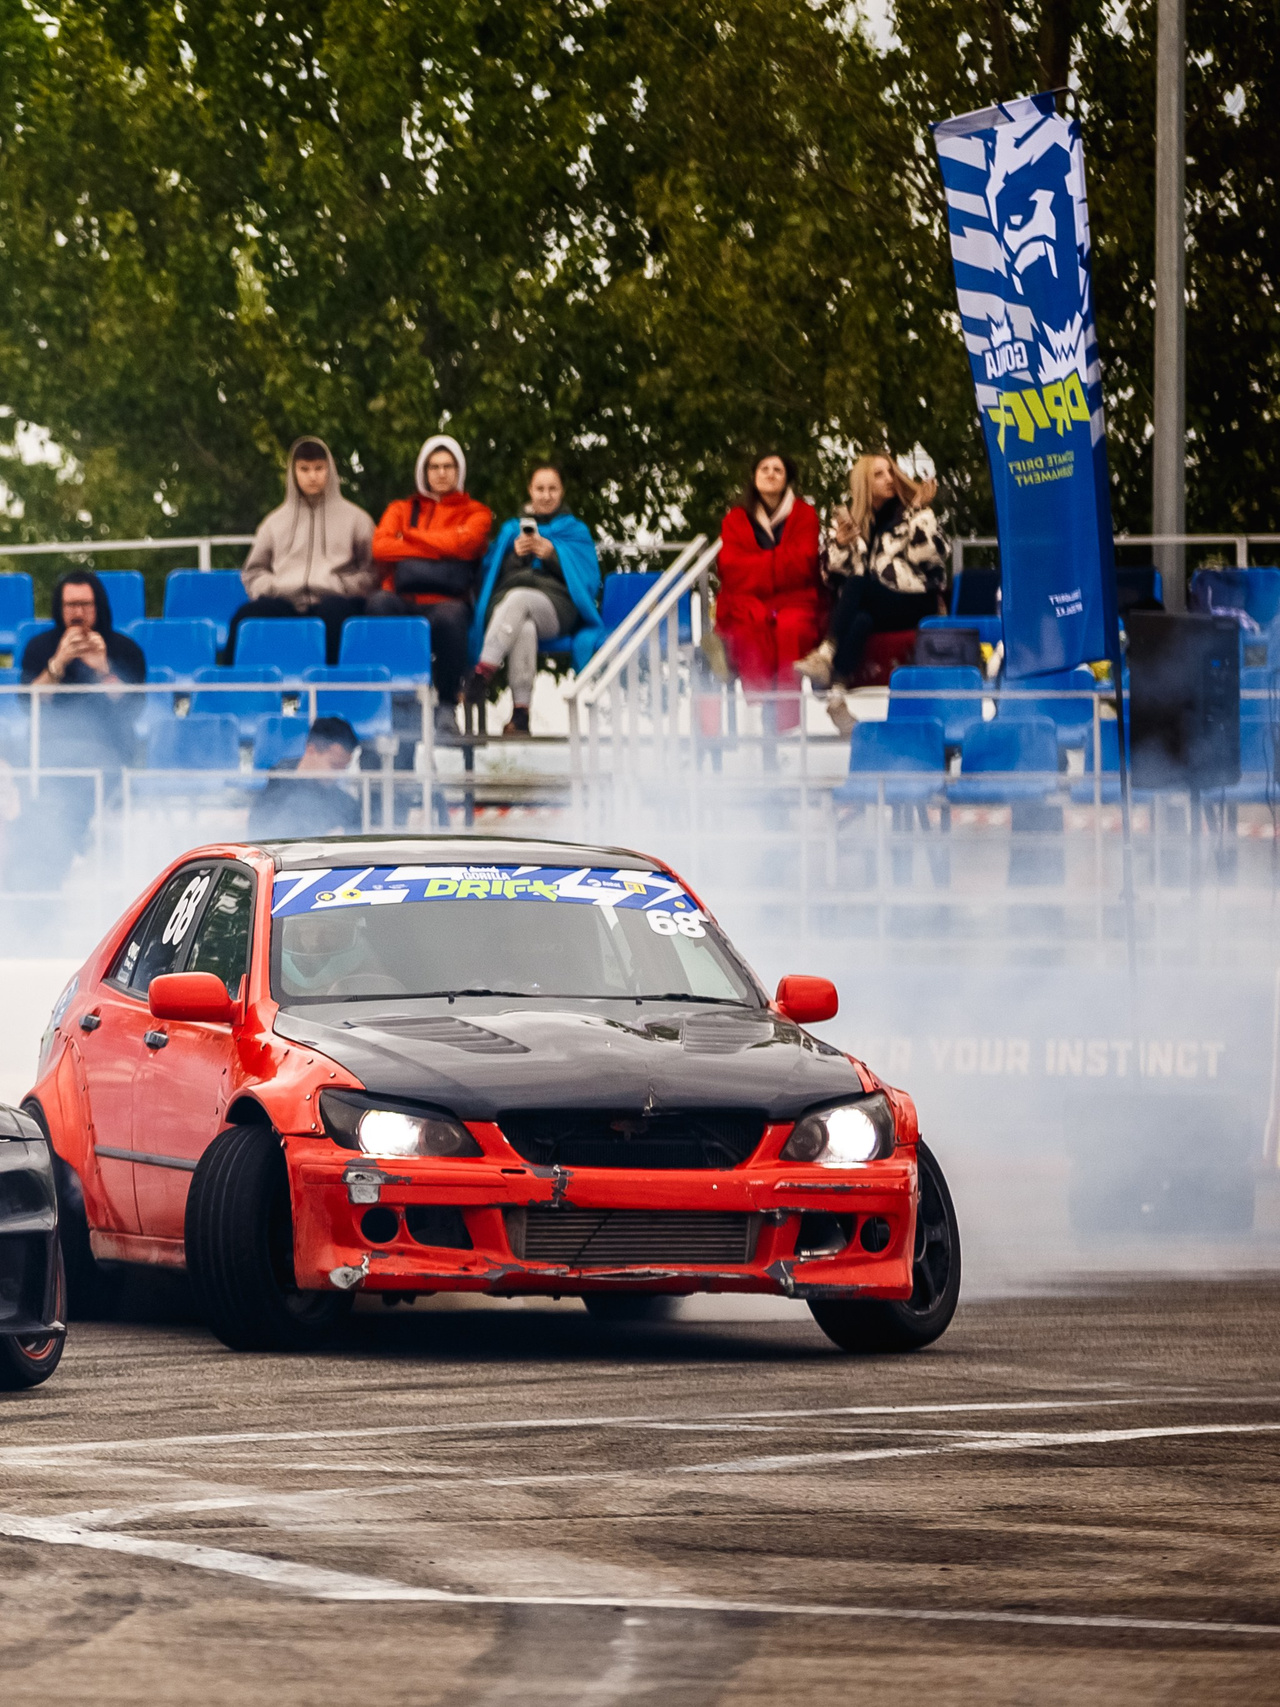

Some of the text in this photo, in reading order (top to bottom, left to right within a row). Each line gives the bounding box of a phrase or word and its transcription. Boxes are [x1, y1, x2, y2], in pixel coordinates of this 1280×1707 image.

[424, 879, 558, 902] DRIFT
[463, 872, 511, 881] GORILLA
[162, 876, 210, 946] 68
[646, 909, 707, 938] 68
[930, 1038, 1030, 1075] YOUR
[1045, 1039, 1226, 1078] INSTINCT
